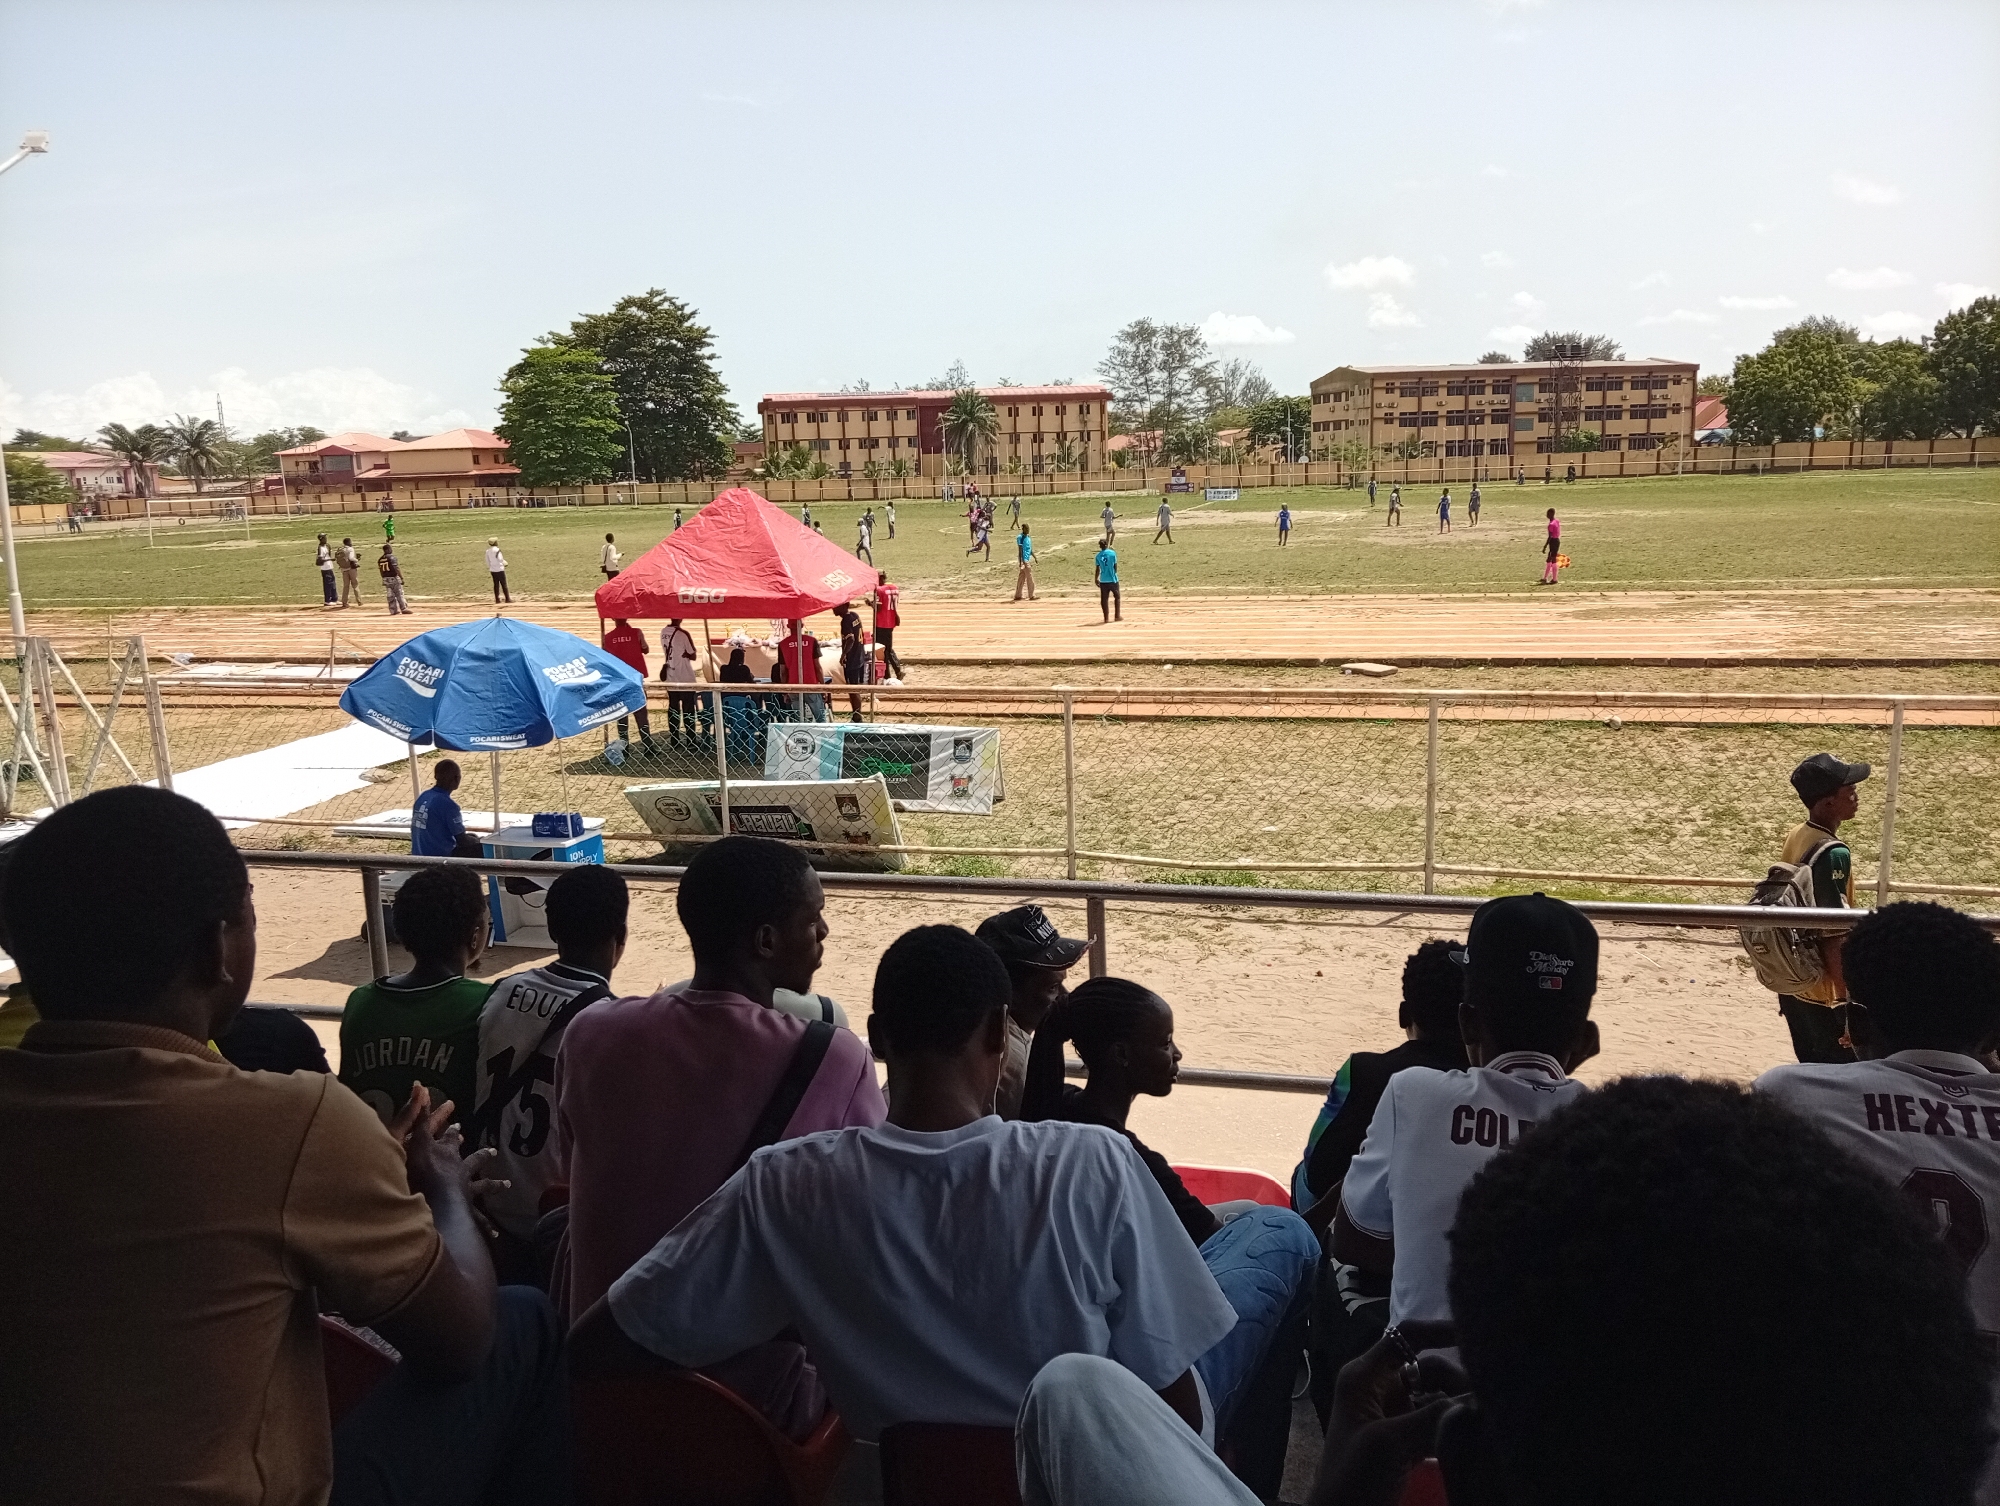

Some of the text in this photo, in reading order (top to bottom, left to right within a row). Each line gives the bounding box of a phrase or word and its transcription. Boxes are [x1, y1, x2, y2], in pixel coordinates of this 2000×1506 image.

[396, 664, 437, 686] SWEAT
[400, 656, 446, 679] POCARI
[542, 656, 588, 677] POCARI
[549, 664, 588, 682] SWEAT
[367, 708, 413, 733] POCARI SWEAT
[578, 700, 625, 725] POCARI SWEAT
[500, 732, 527, 741] SWEAT
[569, 849, 585, 861] ION
[352, 1036, 455, 1078] JORDAN
